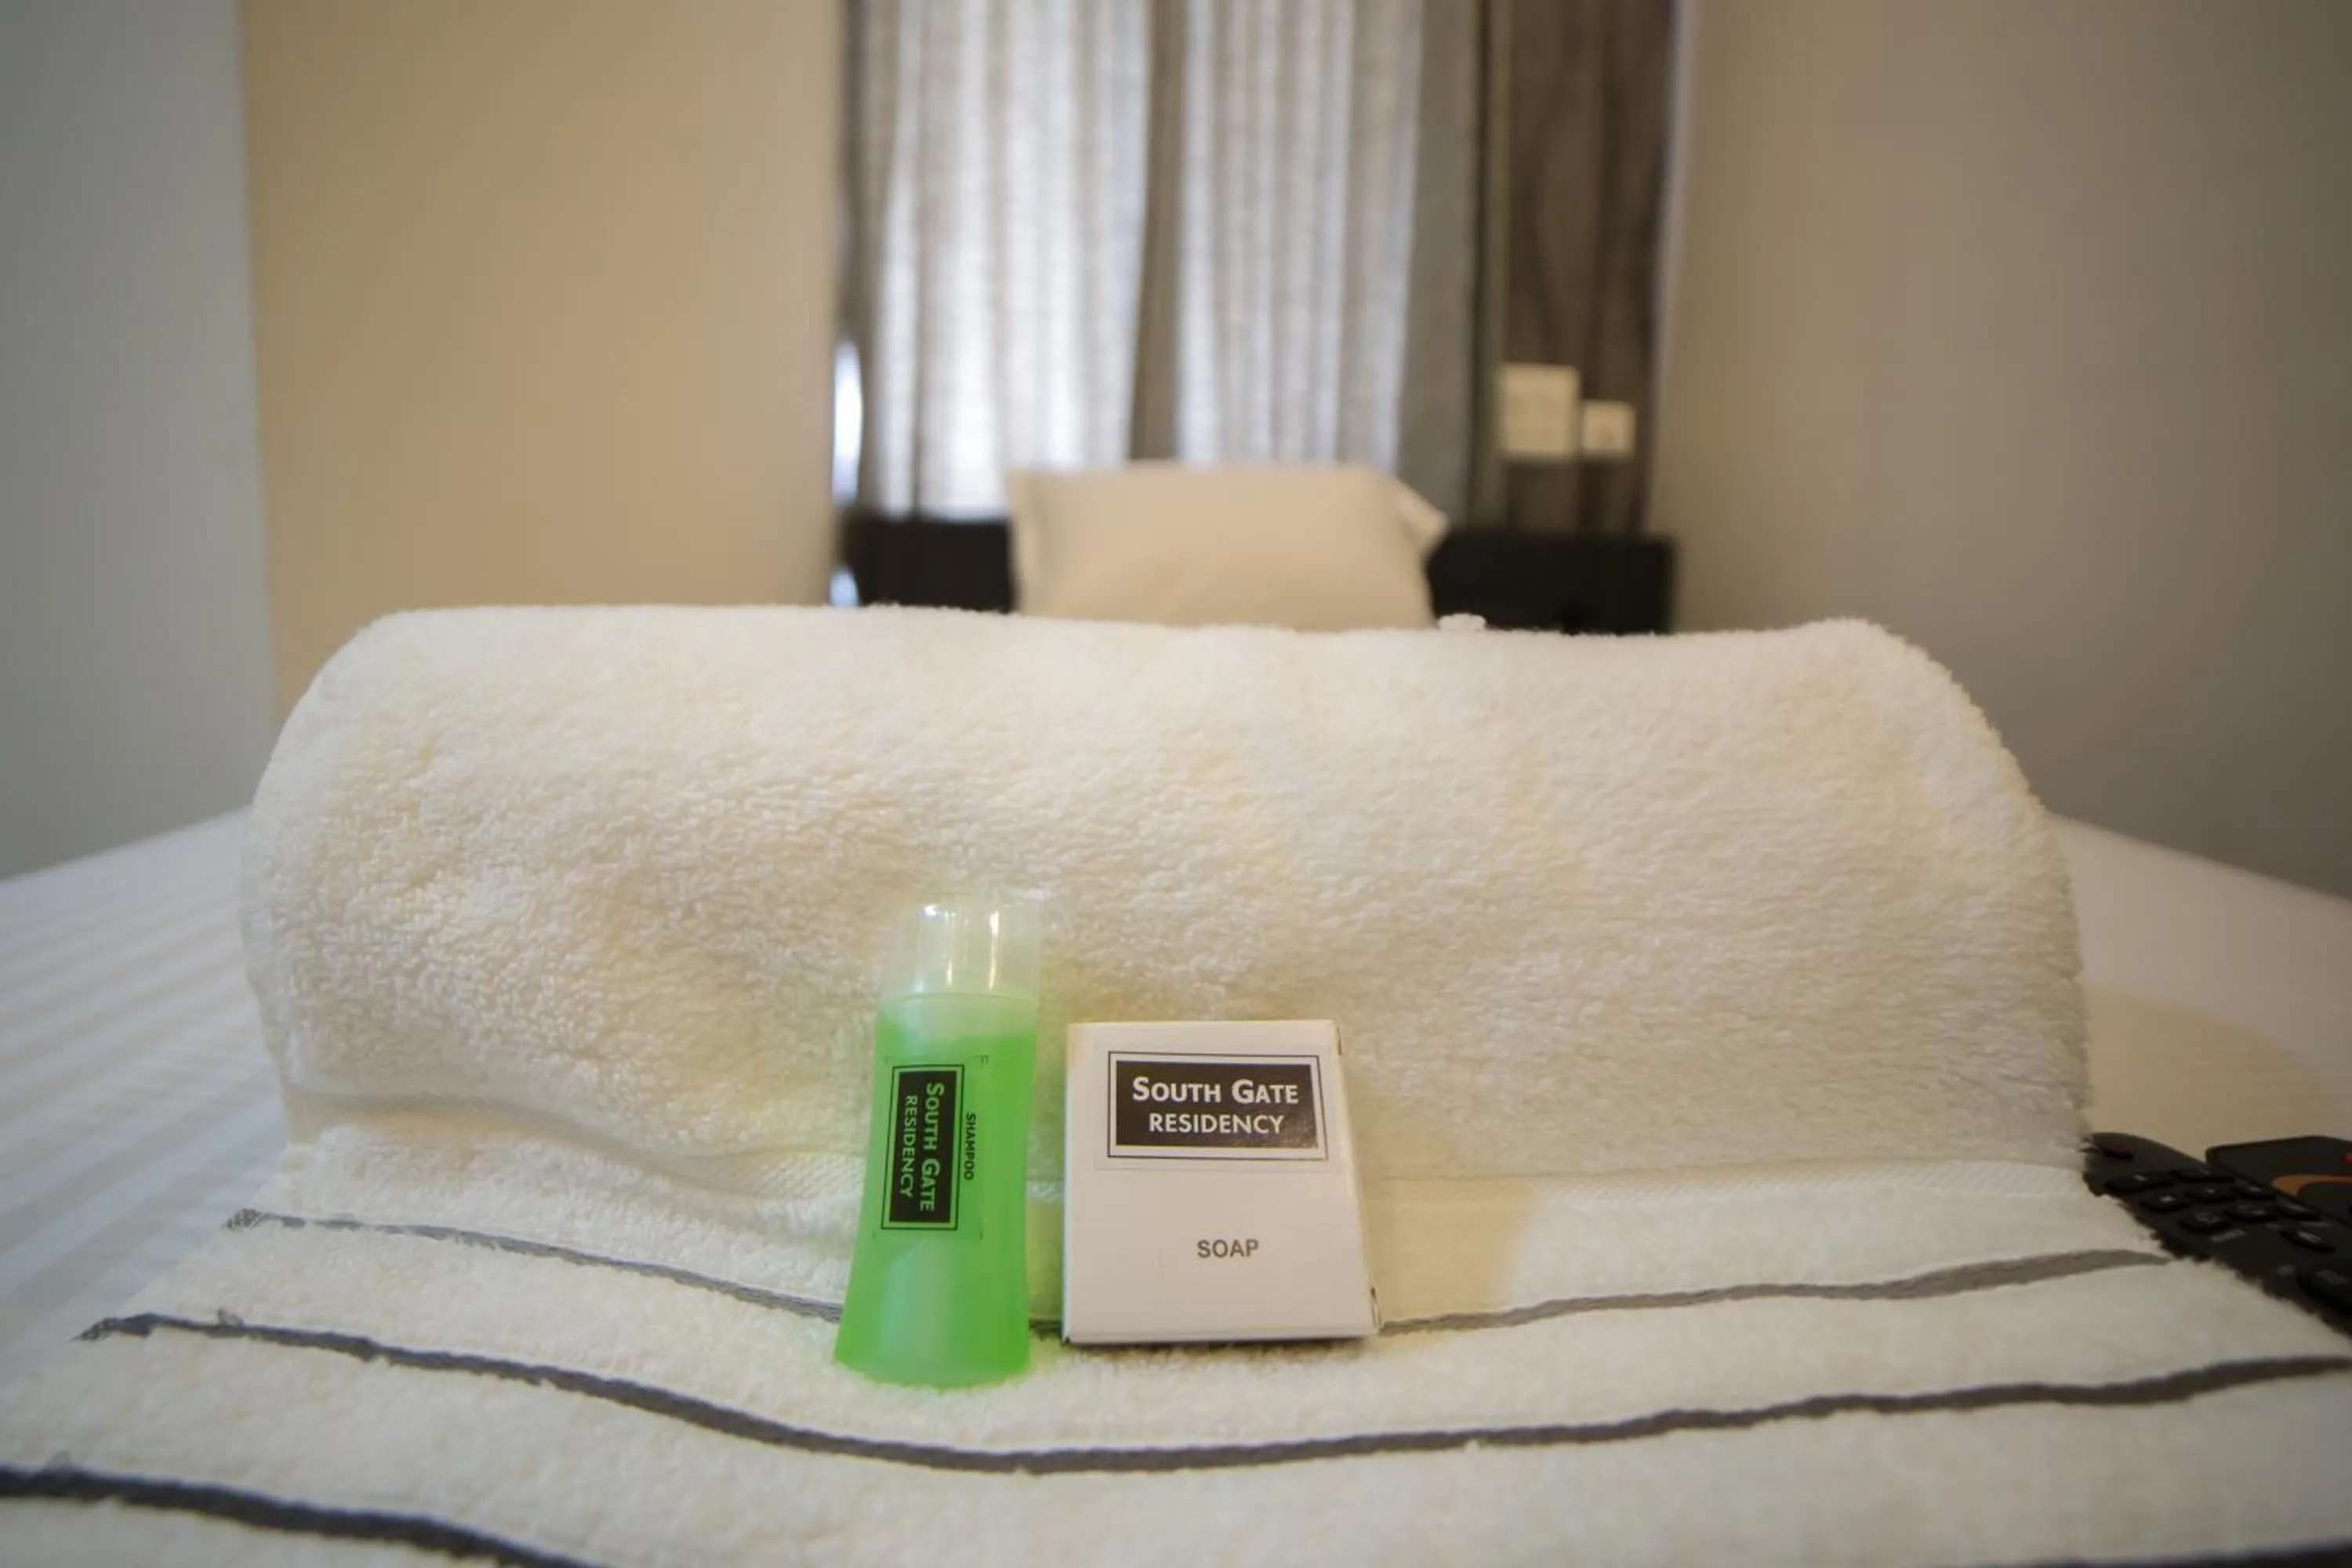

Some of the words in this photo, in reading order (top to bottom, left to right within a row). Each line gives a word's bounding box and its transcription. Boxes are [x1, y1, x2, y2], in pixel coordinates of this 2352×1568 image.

[924, 1082, 944, 1150] SOUTH
[1132, 1076, 1221, 1102] SOUTH
[1232, 1080, 1299, 1105] GATE
[899, 1094, 918, 1198] RESIDENCY
[964, 1112, 976, 1180] SHAMPOO
[1149, 1112, 1284, 1134] RESIDENCY
[920, 1158, 939, 1211] GATE
[1196, 1239, 1259, 1258] SOAP
